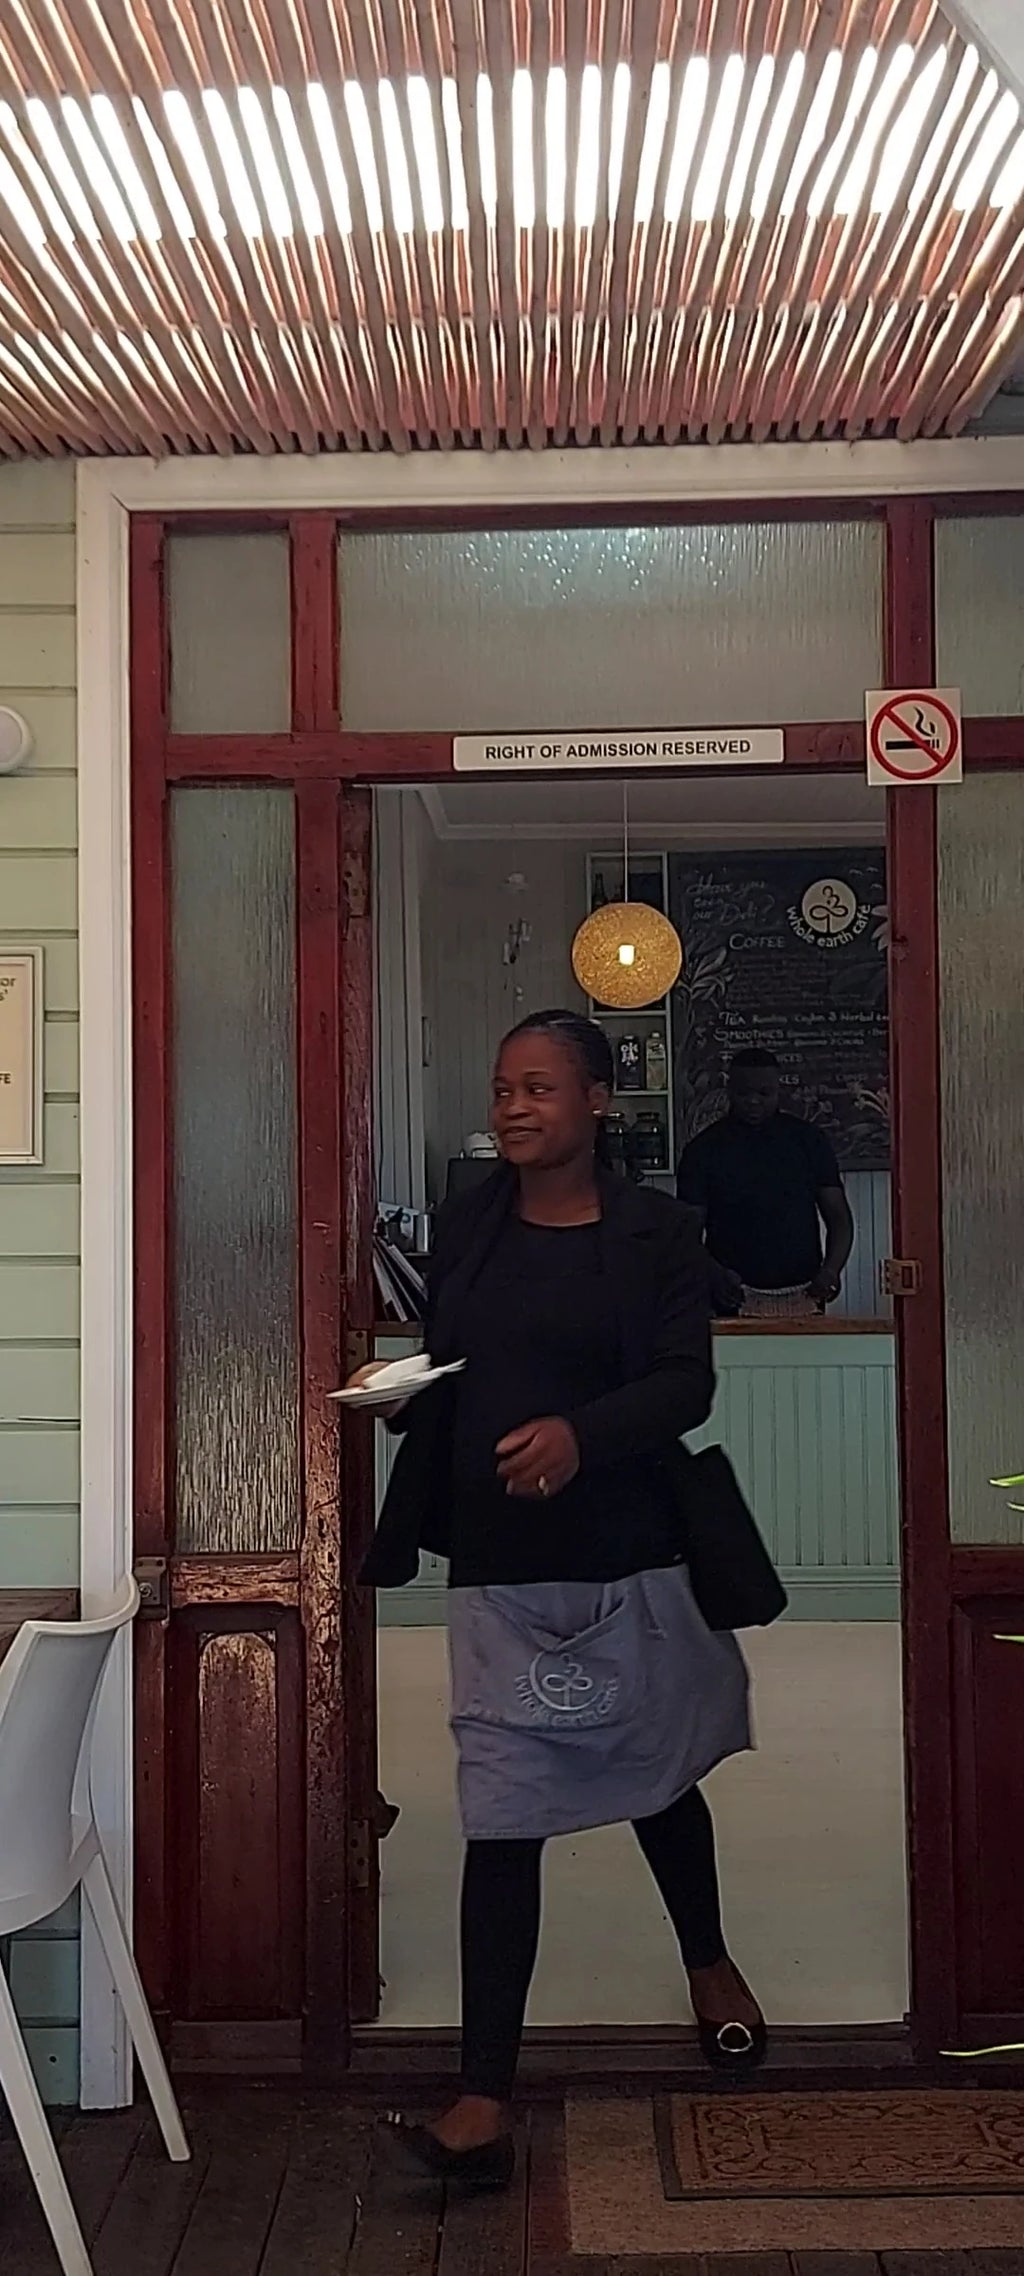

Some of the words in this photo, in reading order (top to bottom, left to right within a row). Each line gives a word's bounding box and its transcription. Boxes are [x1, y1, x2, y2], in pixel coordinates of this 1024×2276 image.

[485, 745, 536, 760] RIGHT
[540, 744, 563, 758] OF
[566, 741, 657, 758] ADMISSION
[661, 739, 752, 756] RESERVED
[686, 873, 732, 895] Have
[734, 881, 766, 898] you
[786, 905, 816, 944] whole
[816, 931, 854, 949] earth
